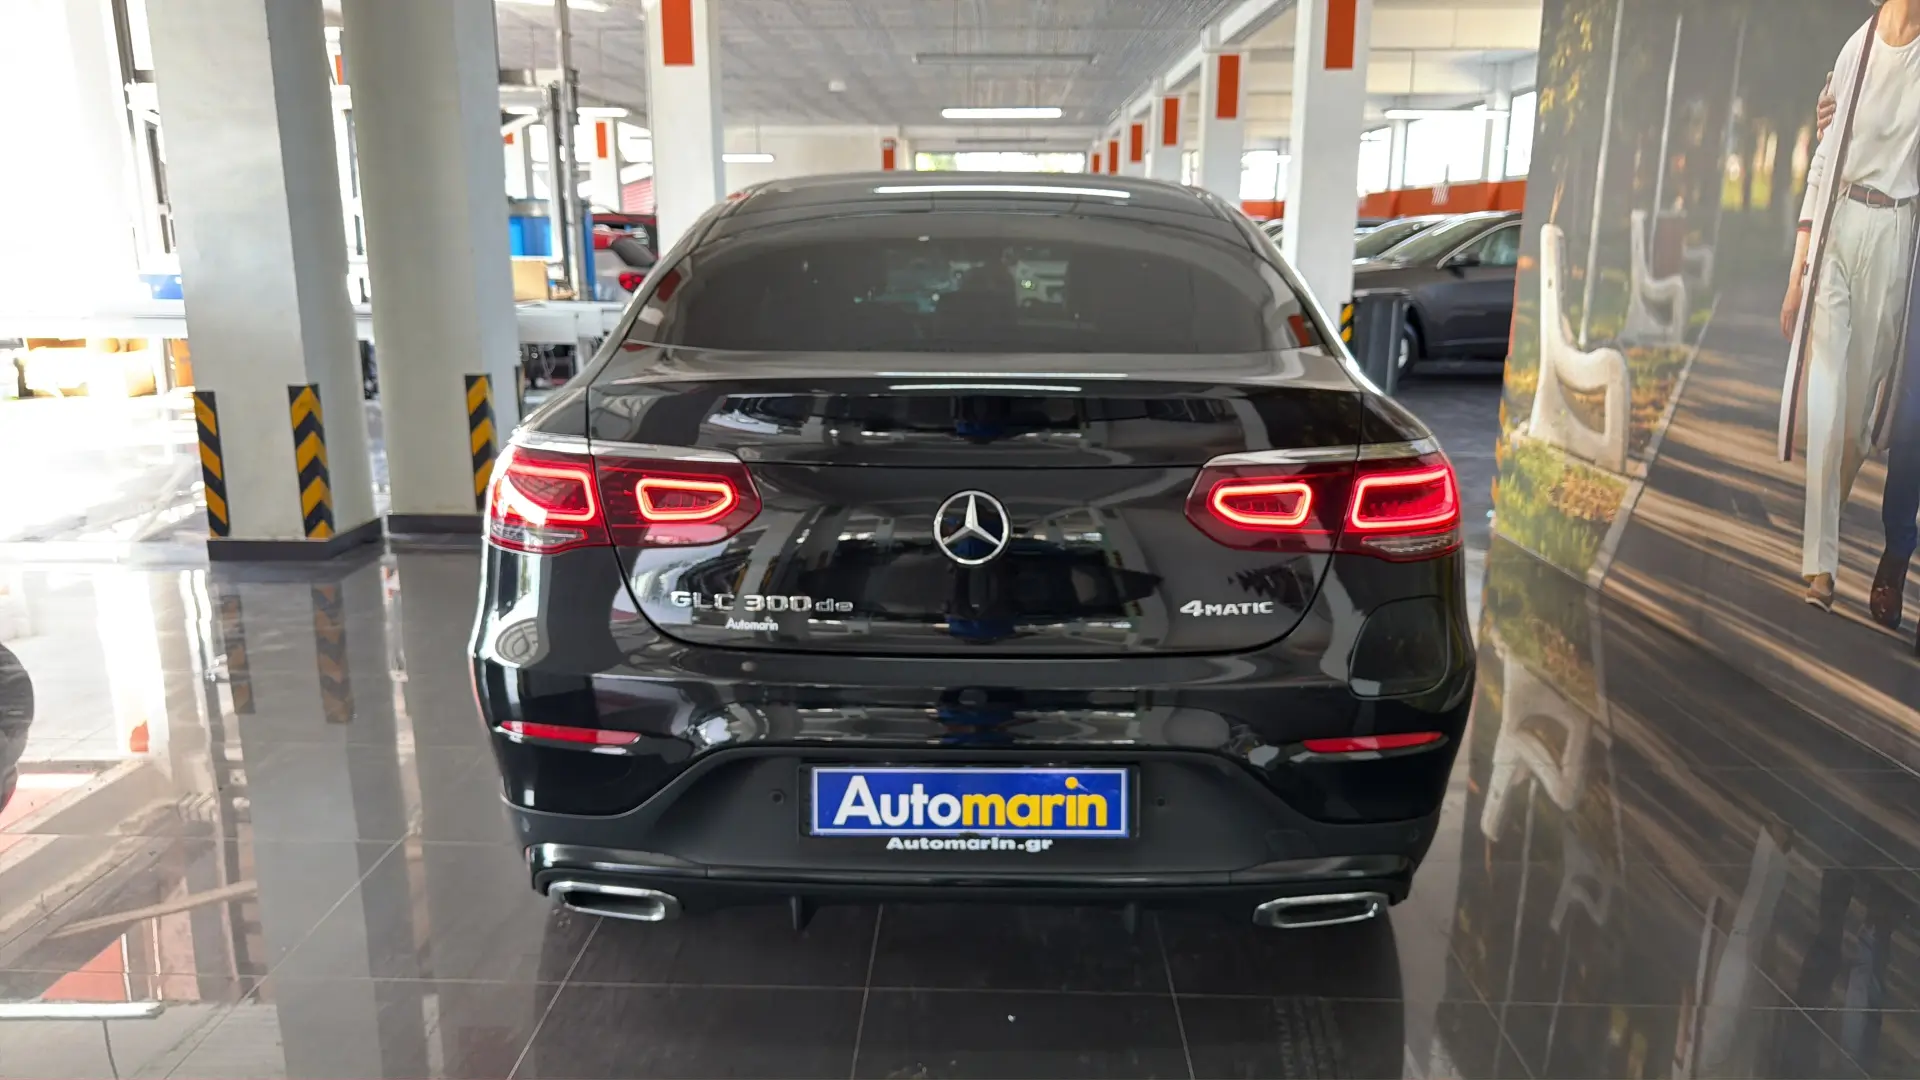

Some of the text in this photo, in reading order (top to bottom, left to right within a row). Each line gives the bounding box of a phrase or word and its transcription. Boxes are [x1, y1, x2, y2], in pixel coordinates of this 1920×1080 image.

[671, 591, 853, 612] GLC 300 de
[1180, 600, 1274, 617] 4MATIC
[725, 616, 779, 632] Automarin
[832, 775, 1108, 827] Automarin
[886, 837, 1053, 853] Automarin.gr
